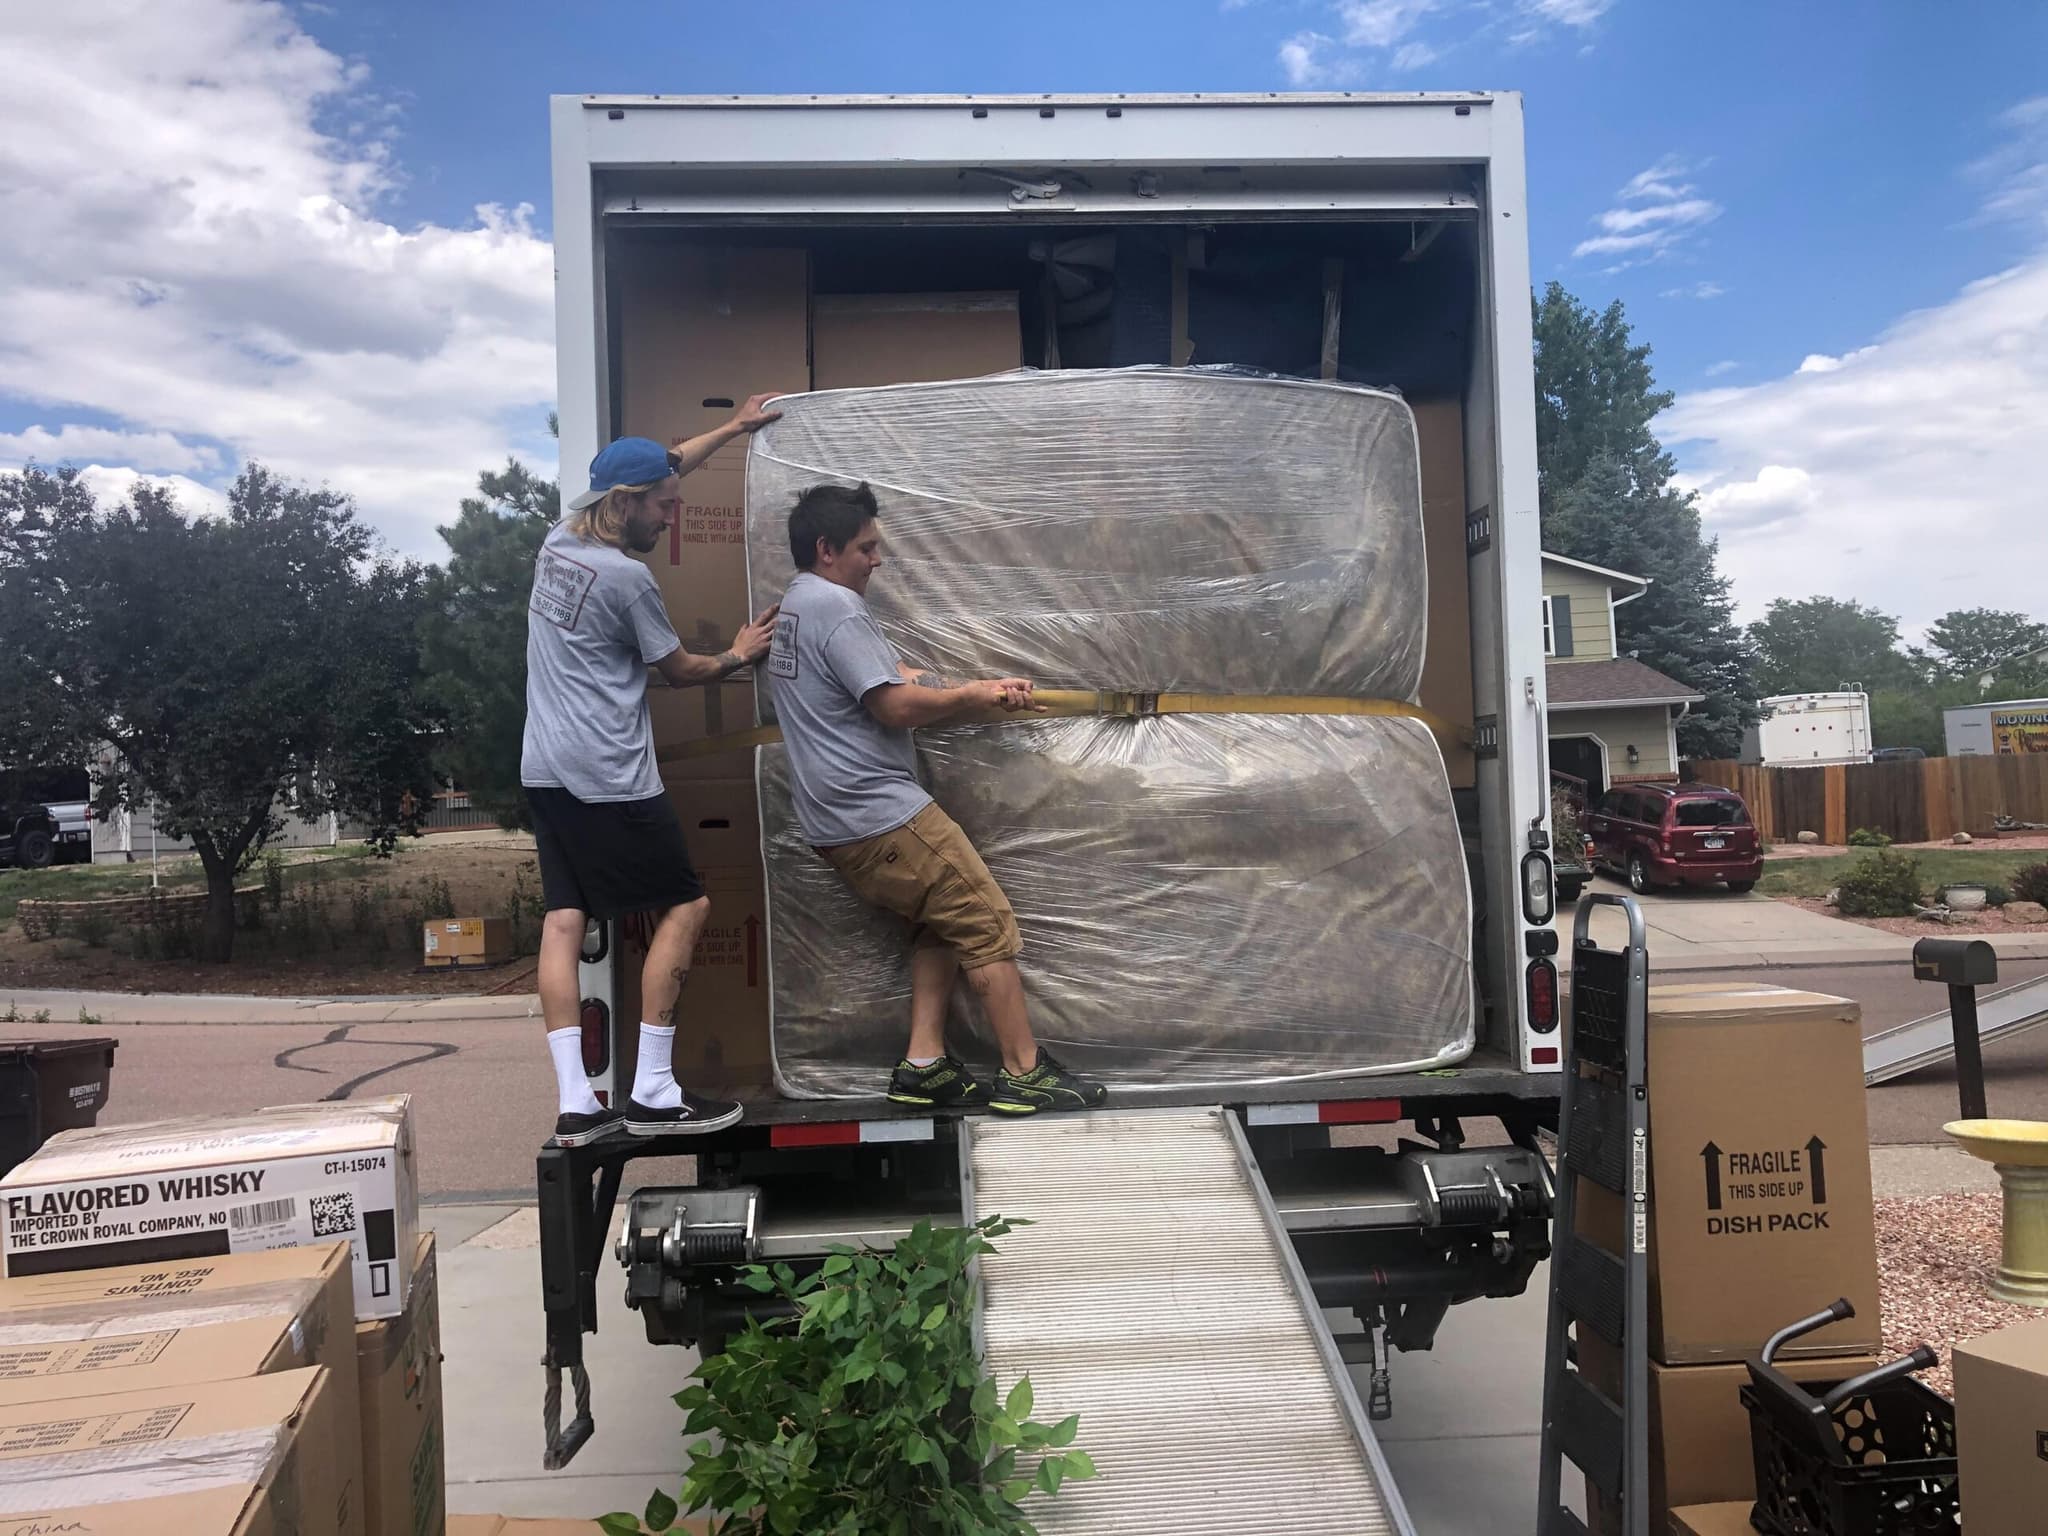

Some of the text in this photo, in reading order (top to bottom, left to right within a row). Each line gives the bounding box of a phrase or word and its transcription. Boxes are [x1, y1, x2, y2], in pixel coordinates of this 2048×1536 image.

[686, 506, 745, 518] FRAGILE
[686, 519, 742, 530] THIS SIDE UP
[702, 927, 742, 938] AGILE
[324, 1156, 387, 1175] CT-I-15074
[1729, 1150, 1801, 1176] FRAGILE
[8, 1169, 266, 1219] FLAVORED WHISKY
[1728, 1181, 1804, 1200] THIS SIDE UP
[10, 1210, 101, 1233] IMPORTED BY
[10, 1210, 227, 1248] THE CROWN ROYAL COMPANY, NO
[1706, 1210, 1831, 1236] DISH PACK
[103, 1278, 204, 1296] CONTENTS
